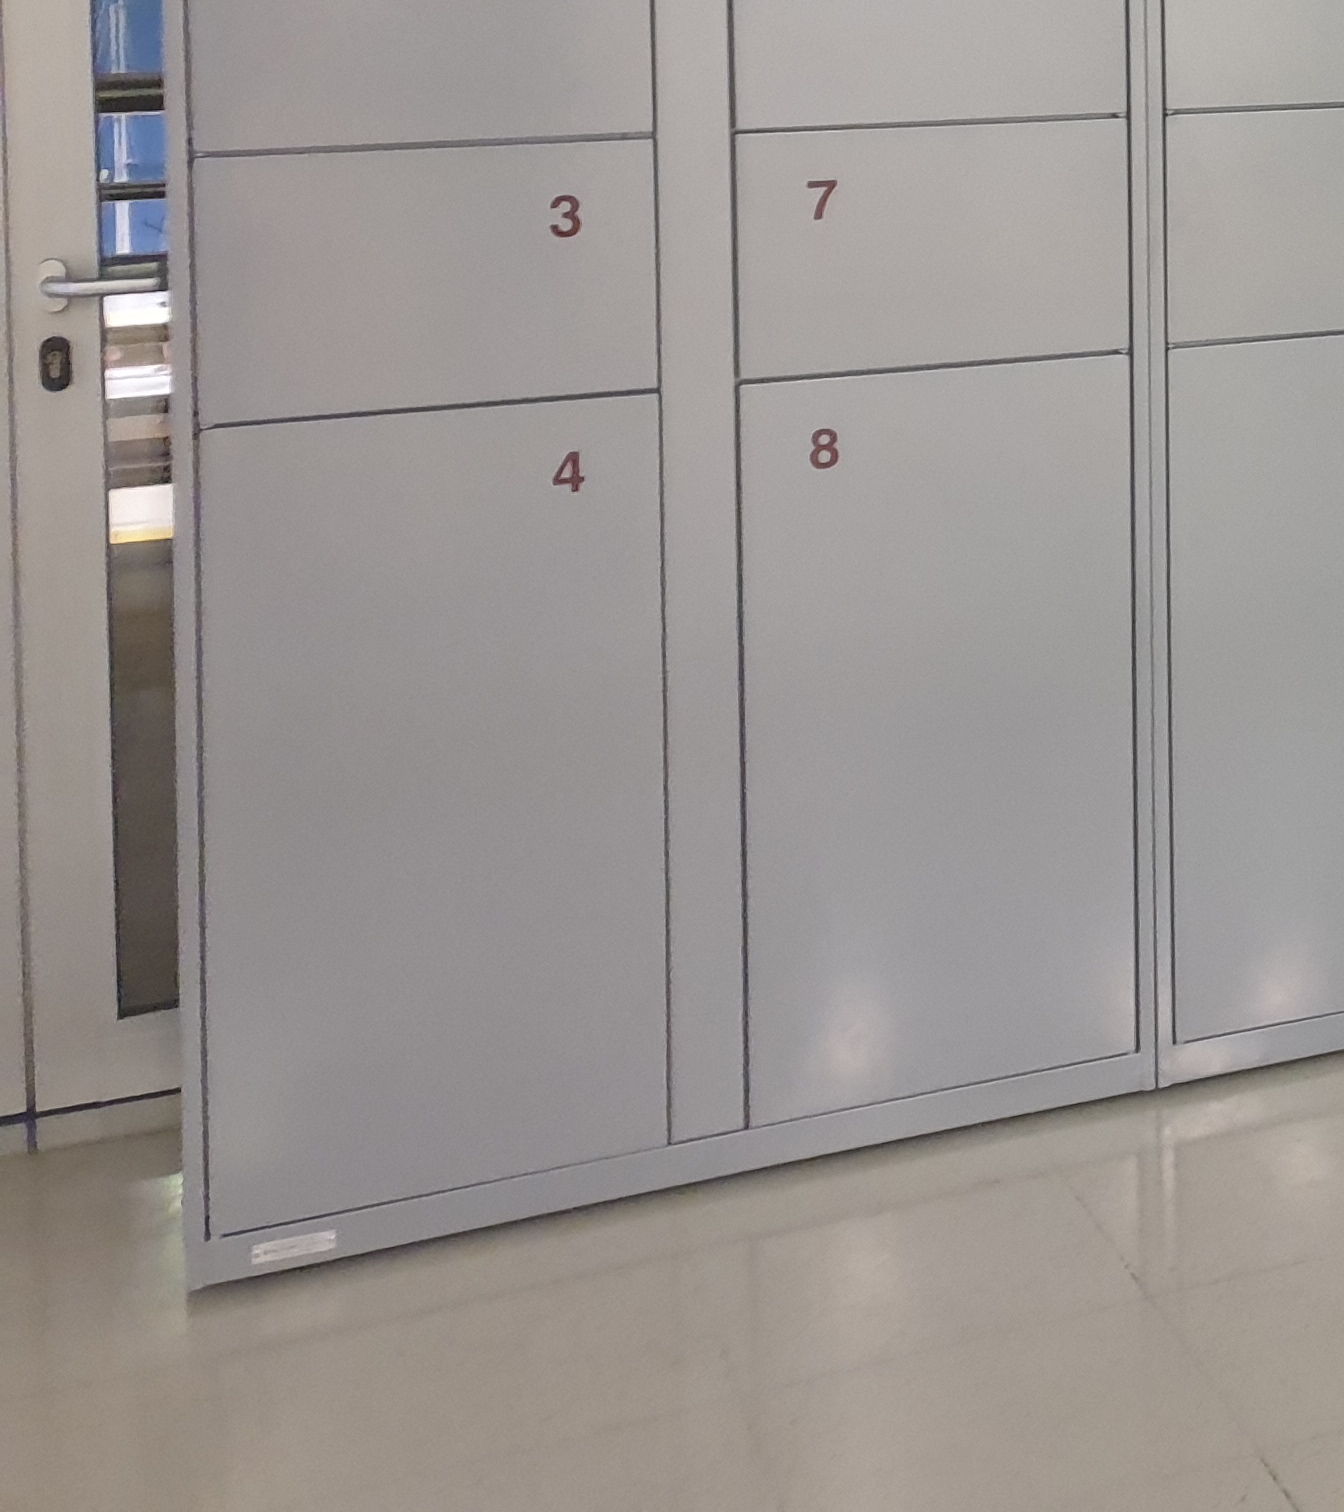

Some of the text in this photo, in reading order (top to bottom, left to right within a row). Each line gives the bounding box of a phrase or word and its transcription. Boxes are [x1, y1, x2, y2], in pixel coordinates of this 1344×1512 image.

[549, 195, 582, 239] 3
[806, 180, 838, 221] 7
[809, 429, 840, 470] 8
[552, 452, 586, 493] 4
